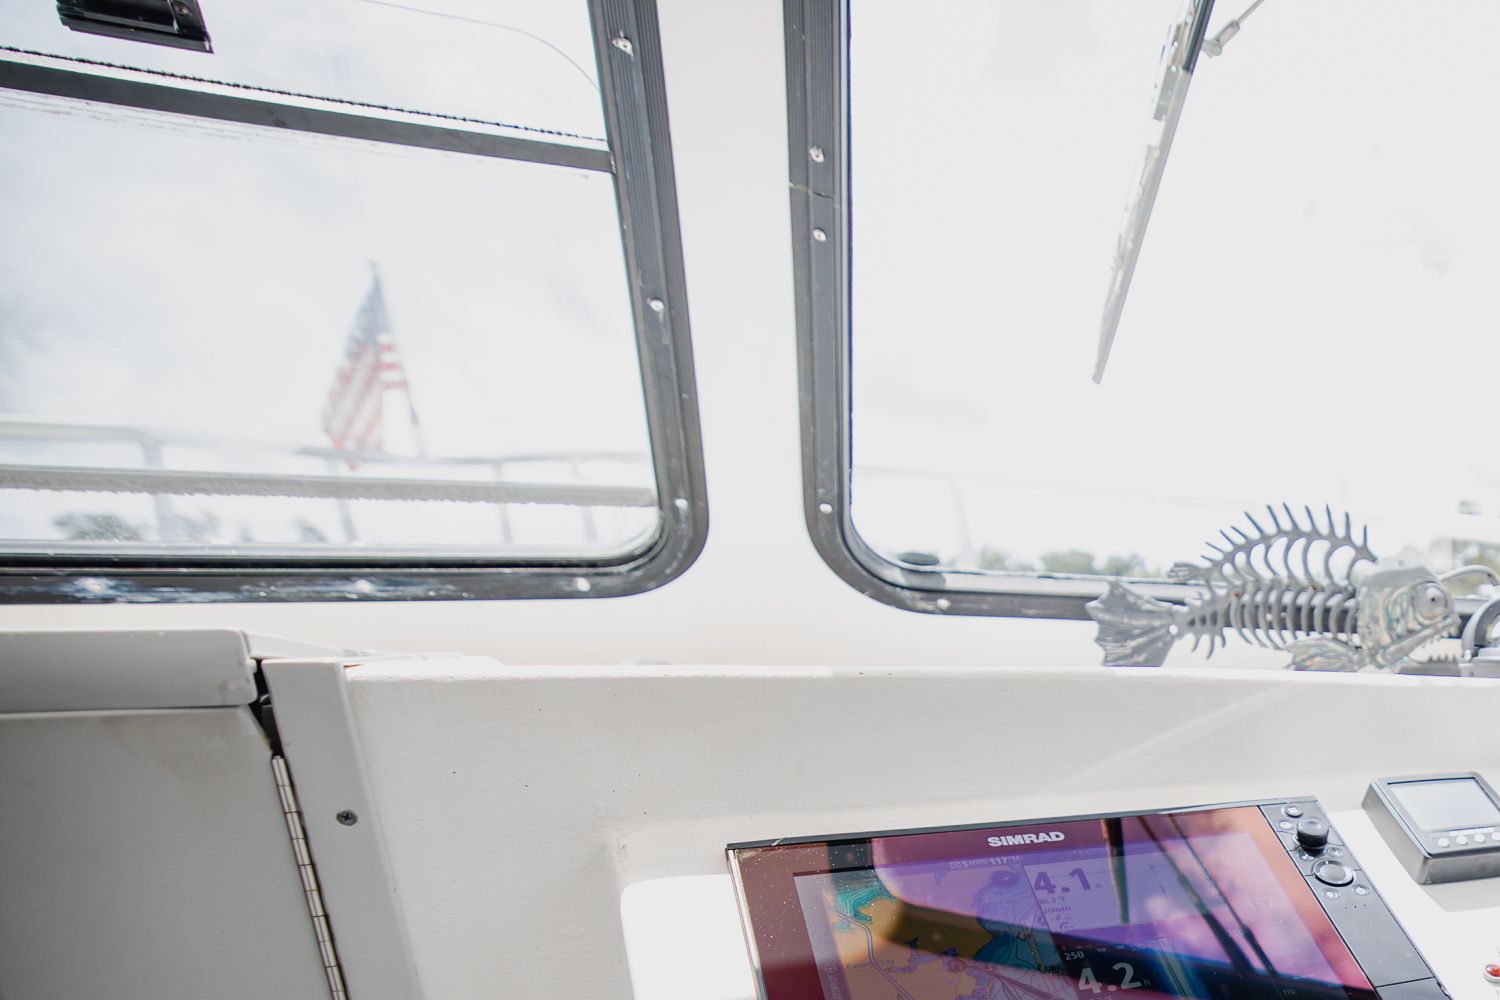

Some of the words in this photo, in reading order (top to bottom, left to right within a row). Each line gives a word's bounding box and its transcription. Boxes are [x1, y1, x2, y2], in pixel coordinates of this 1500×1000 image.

[987, 831, 1065, 847] SIMRAD
[1034, 867, 1092, 894] 4.1
[1064, 950, 1085, 961] 250
[1078, 962, 1143, 994] 4.2
